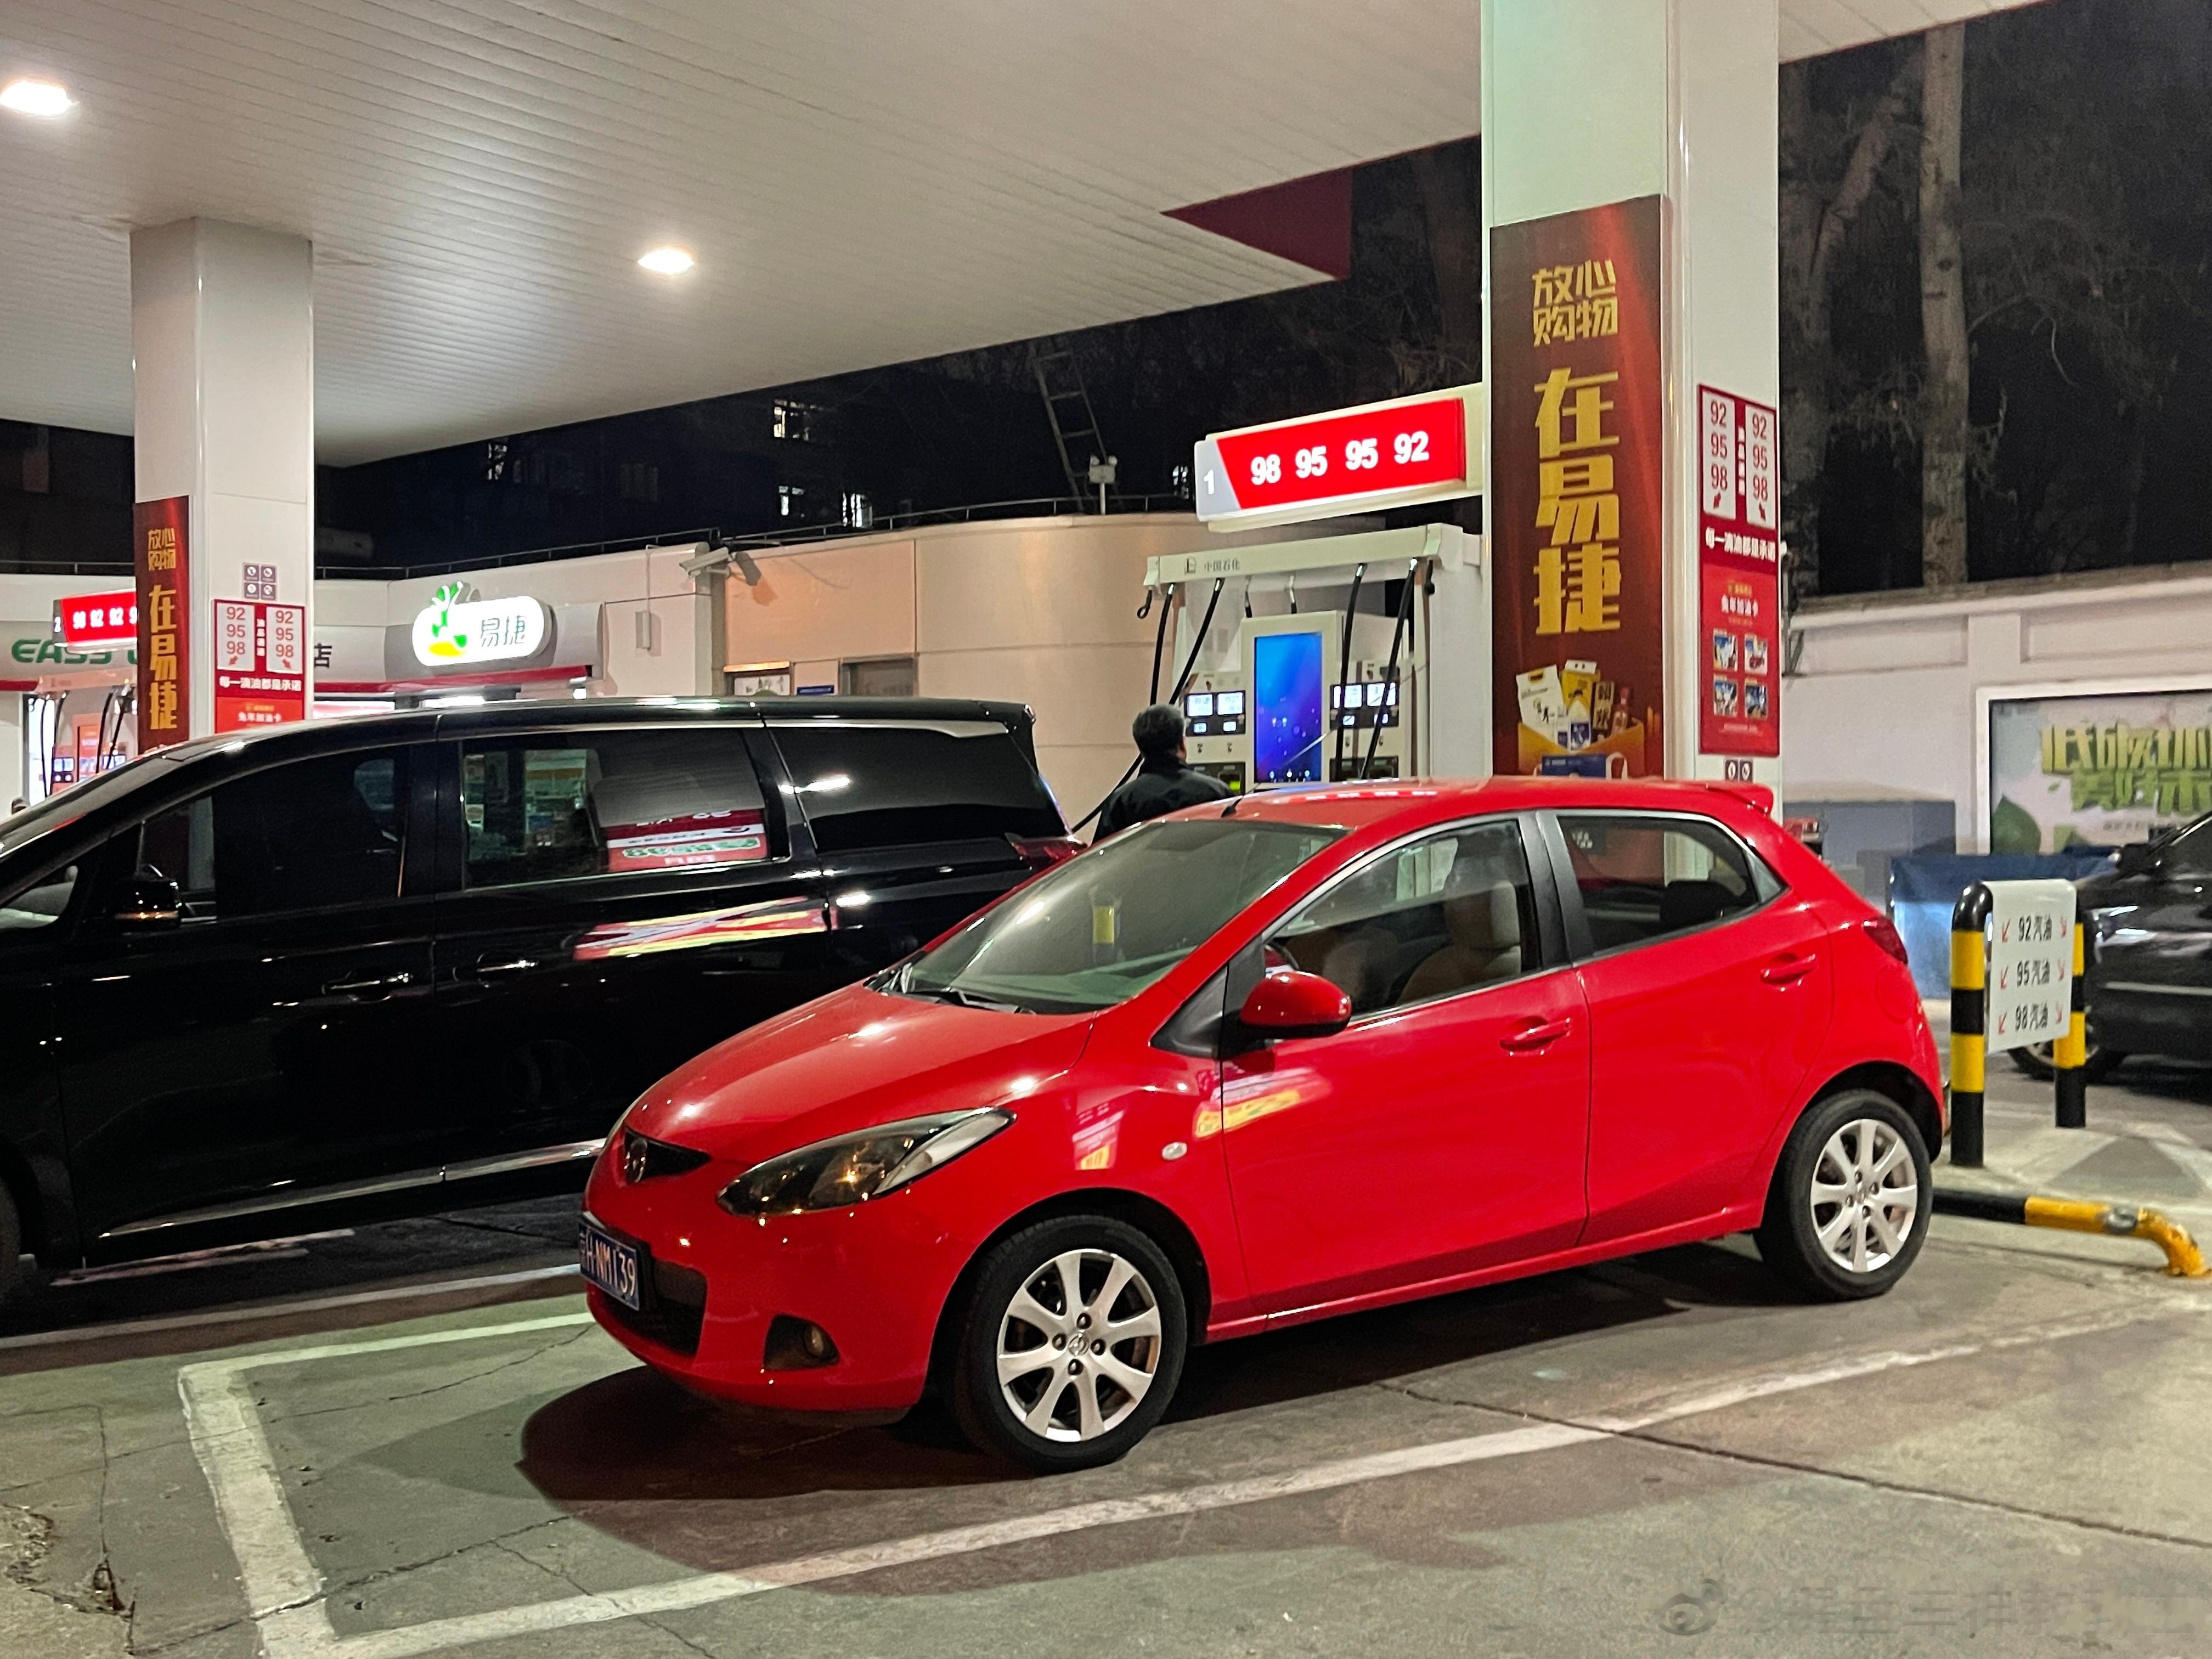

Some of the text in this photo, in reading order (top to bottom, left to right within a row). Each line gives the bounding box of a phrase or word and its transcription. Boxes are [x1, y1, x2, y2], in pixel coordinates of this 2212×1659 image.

[1532, 259, 1617, 307] 放心
[1533, 300, 1618, 347] 购物
[1711, 400, 1727, 428] 92
[1752, 413, 1767, 439] 92
[1711, 432, 1728, 460] 95
[1753, 444, 1768, 470] 95
[1203, 431, 1430, 494] 1 98 95 95 92
[1711, 464, 1728, 491] 98
[1753, 474, 1769, 501] 98
[1534, 367, 1621, 635] 在易捷
[148, 527, 176, 548] 放心
[148, 548, 176, 571] 购物
[226, 606, 246, 620] 92
[275, 610, 294, 624] 92
[226, 624, 246, 638] 95
[275, 627, 294, 641] 95
[480, 614, 526, 647] 易捷
[149, 584, 178, 730] 在易捷
[226, 640, 246, 656] 98
[275, 644, 294, 658] 98
